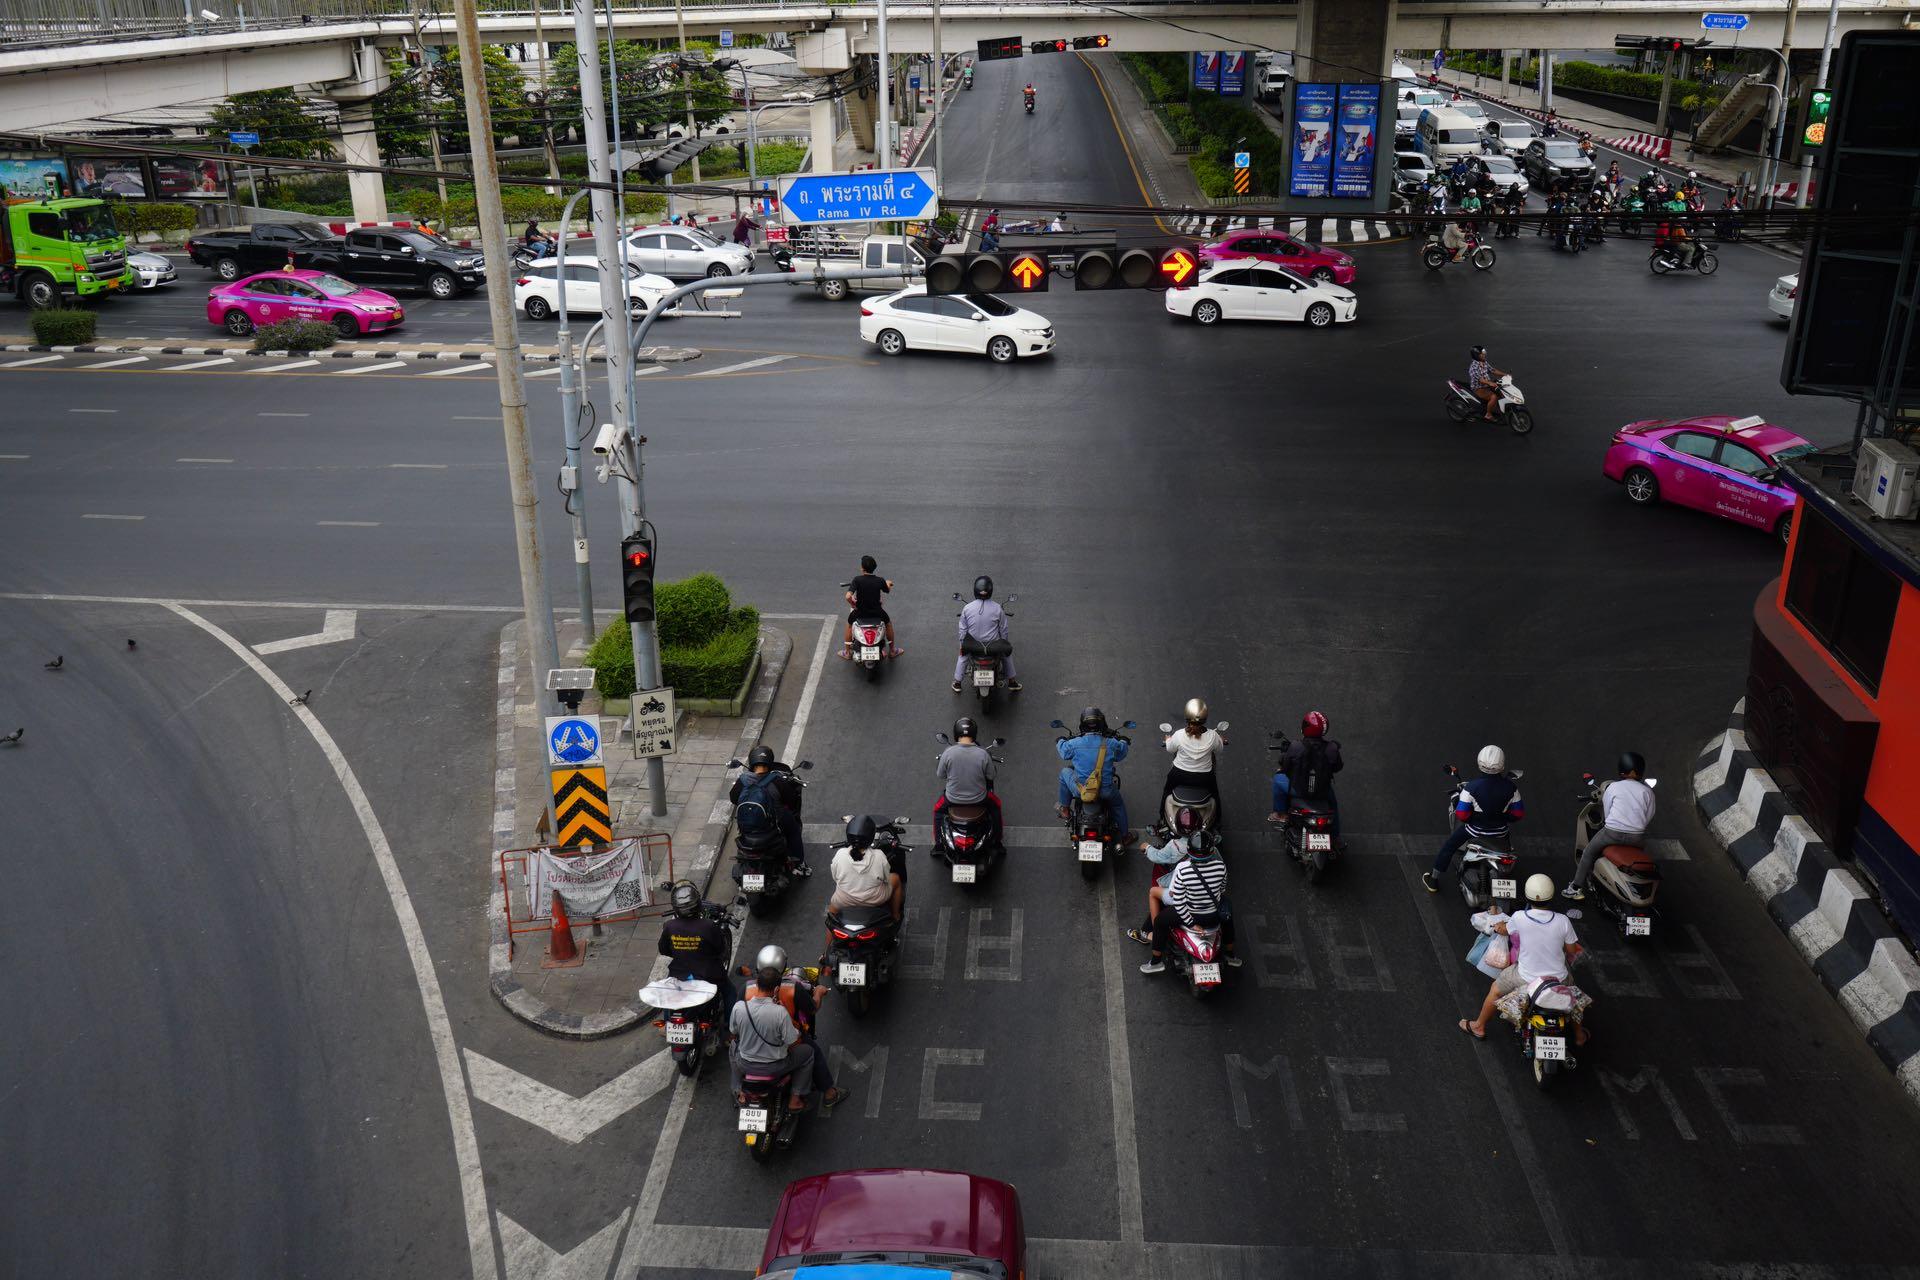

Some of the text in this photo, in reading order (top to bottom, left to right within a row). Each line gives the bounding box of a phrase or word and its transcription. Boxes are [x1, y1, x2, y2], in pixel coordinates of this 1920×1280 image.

[799, 173, 916, 204] ถ. พระรามที่ ๔
[818, 205, 901, 219] Rama IV Rd.
[579, 541, 585, 550] 2
[636, 725, 673, 740] สัญญาณไฟ
[640, 740, 655, 754] ที่นี่
[1543, 1051, 1559, 1059] 197
[1224, 1053, 1408, 1131] MC
[1597, 1063, 1806, 1145] MC
